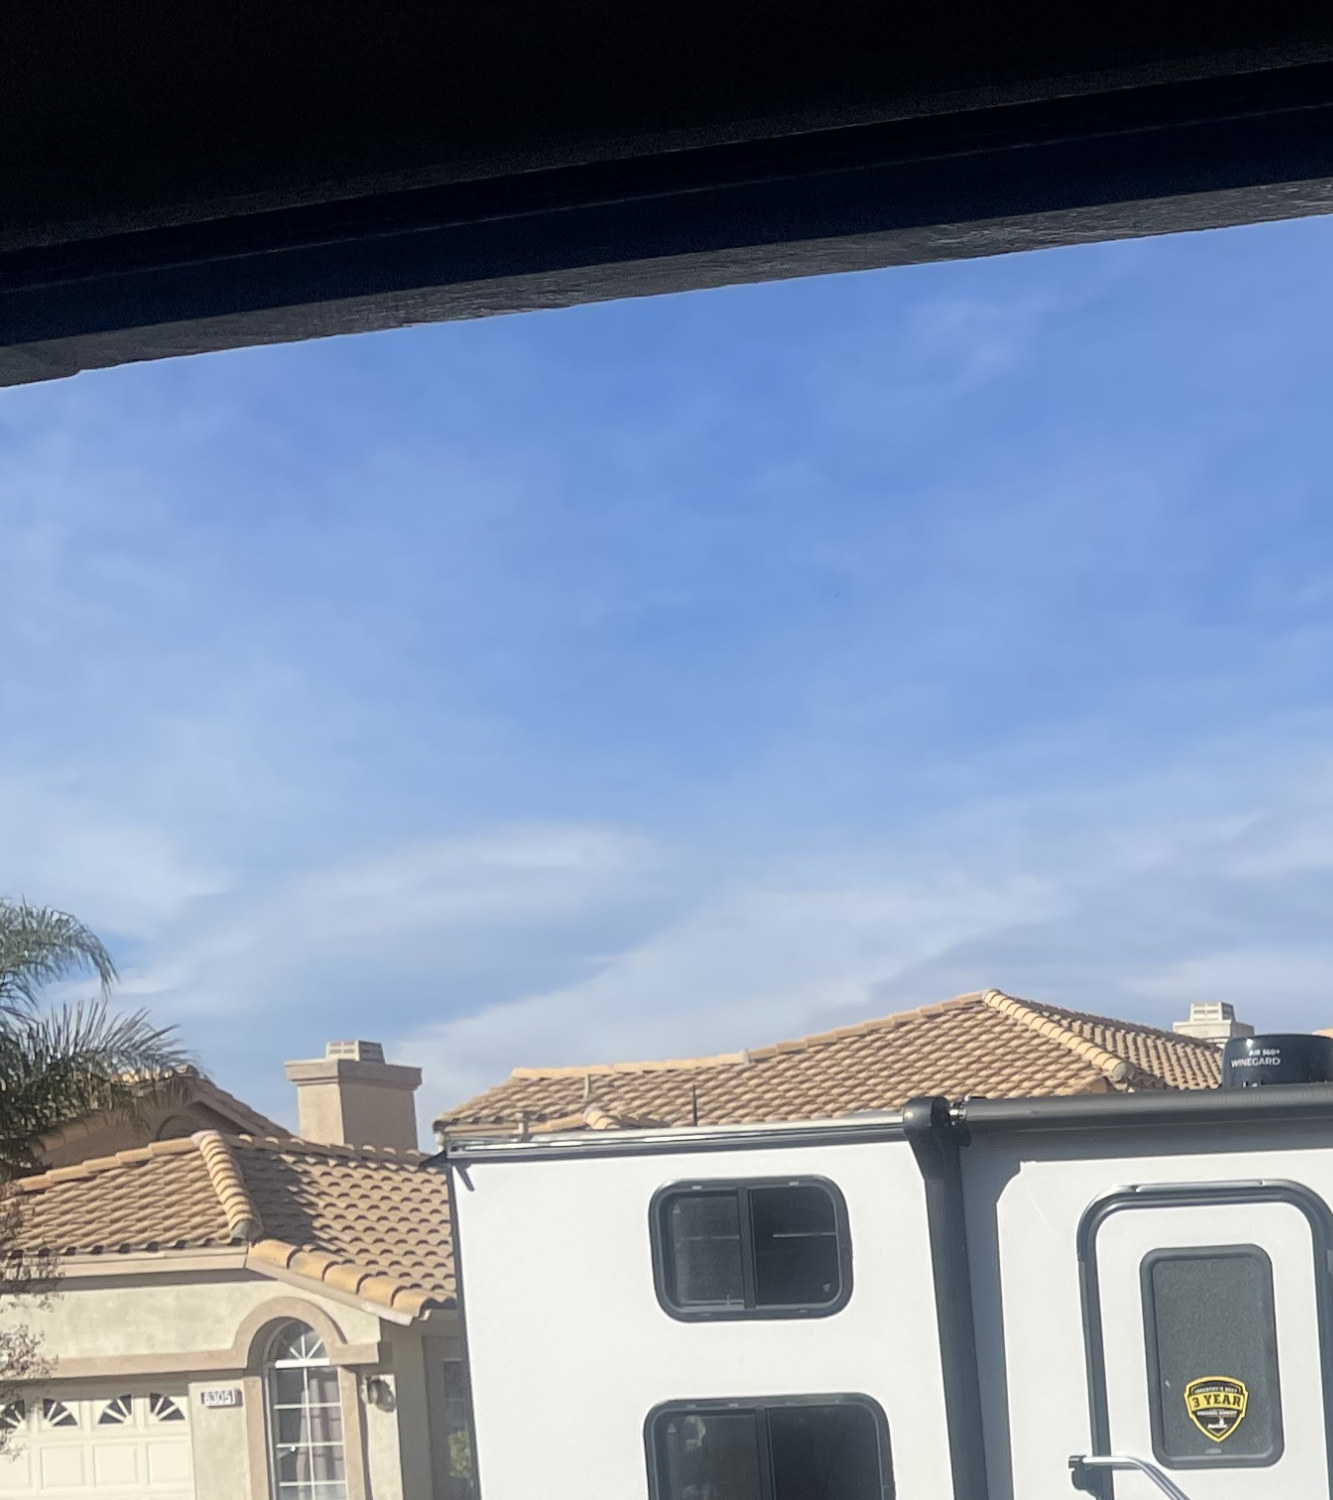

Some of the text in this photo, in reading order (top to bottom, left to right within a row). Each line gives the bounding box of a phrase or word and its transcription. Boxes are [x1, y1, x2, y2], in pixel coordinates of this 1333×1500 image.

[1230, 1057, 1281, 1068] WINEGARD
[1191, 1394, 1241, 1408] 3 YEAR
